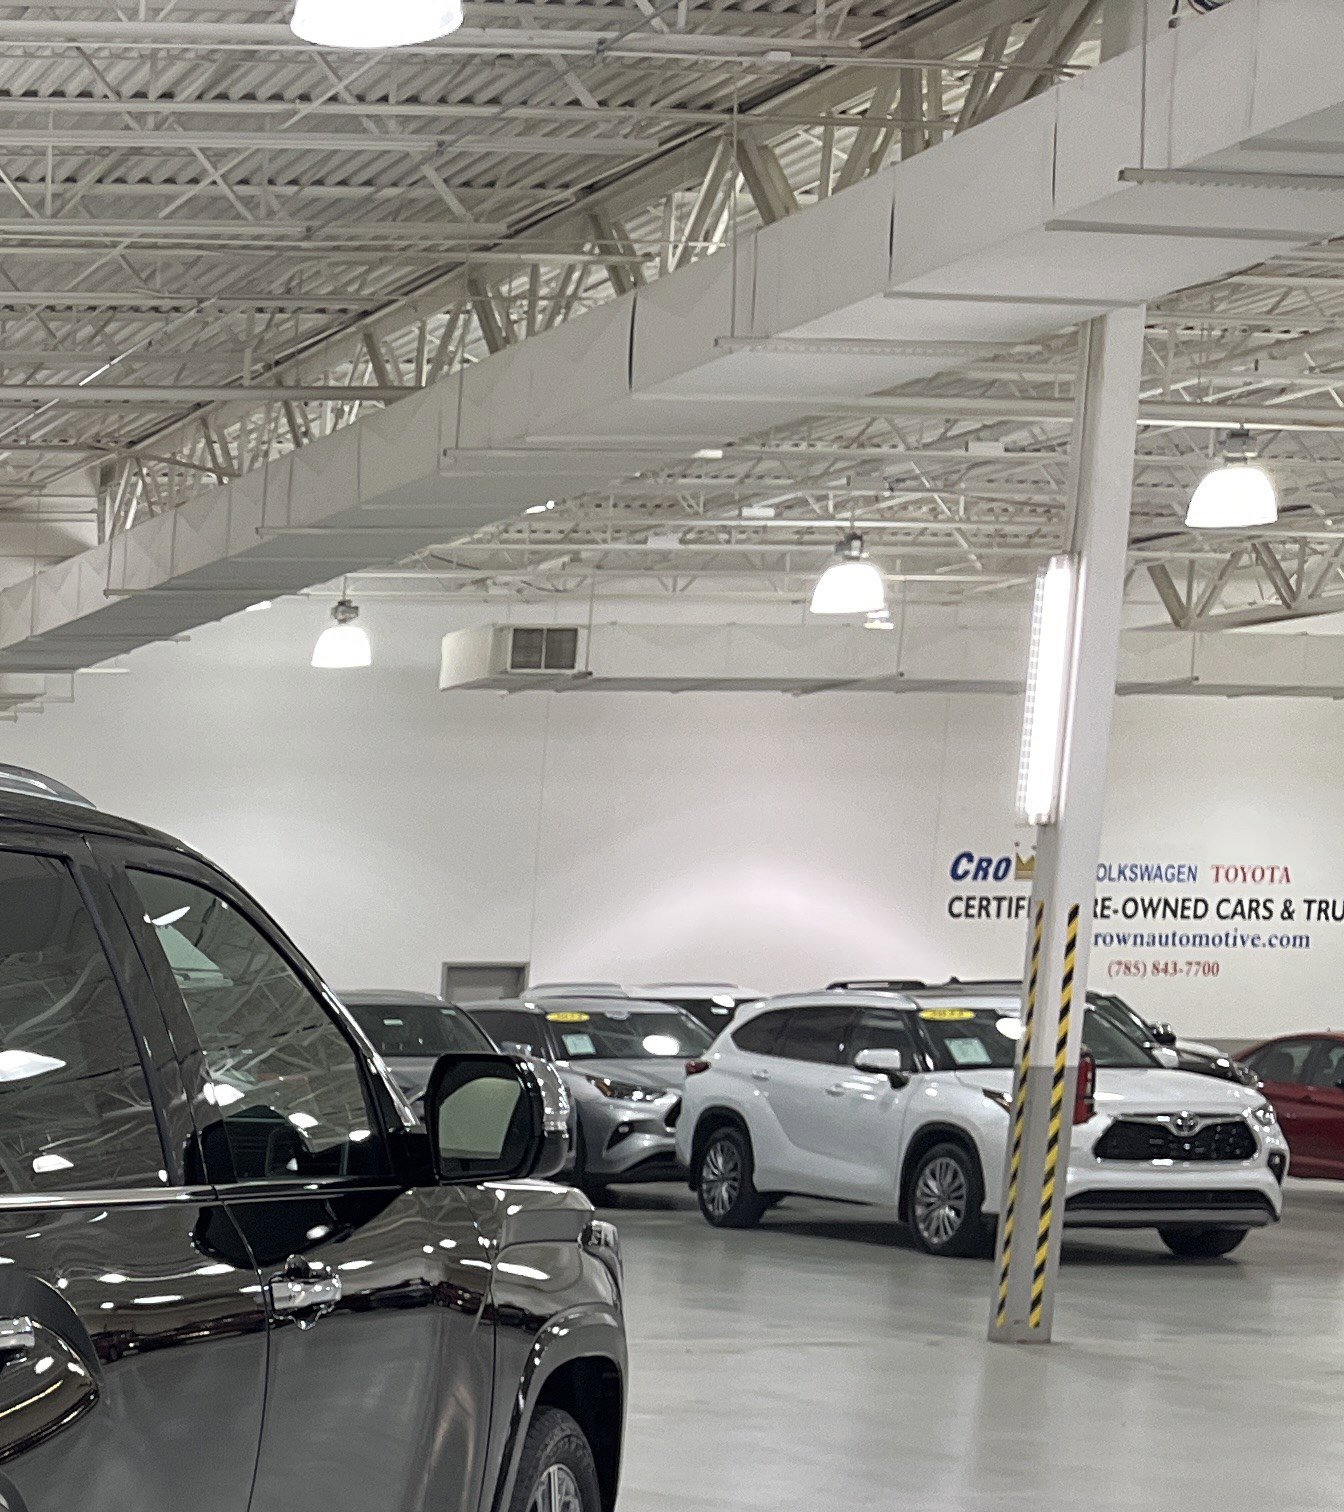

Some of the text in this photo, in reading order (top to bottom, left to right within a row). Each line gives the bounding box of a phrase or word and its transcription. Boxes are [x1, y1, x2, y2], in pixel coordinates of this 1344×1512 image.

[1095, 863, 1291, 883] OLKSWAGEN TOYOTA
[948, 895, 1032, 920] CERTIFI
[1216, 898, 1275, 921] CARS
[1280, 898, 1296, 921] &
[1094, 927, 1311, 949] rownautomotive.com
[1108, 960, 1220, 978] (785) 843-7700
